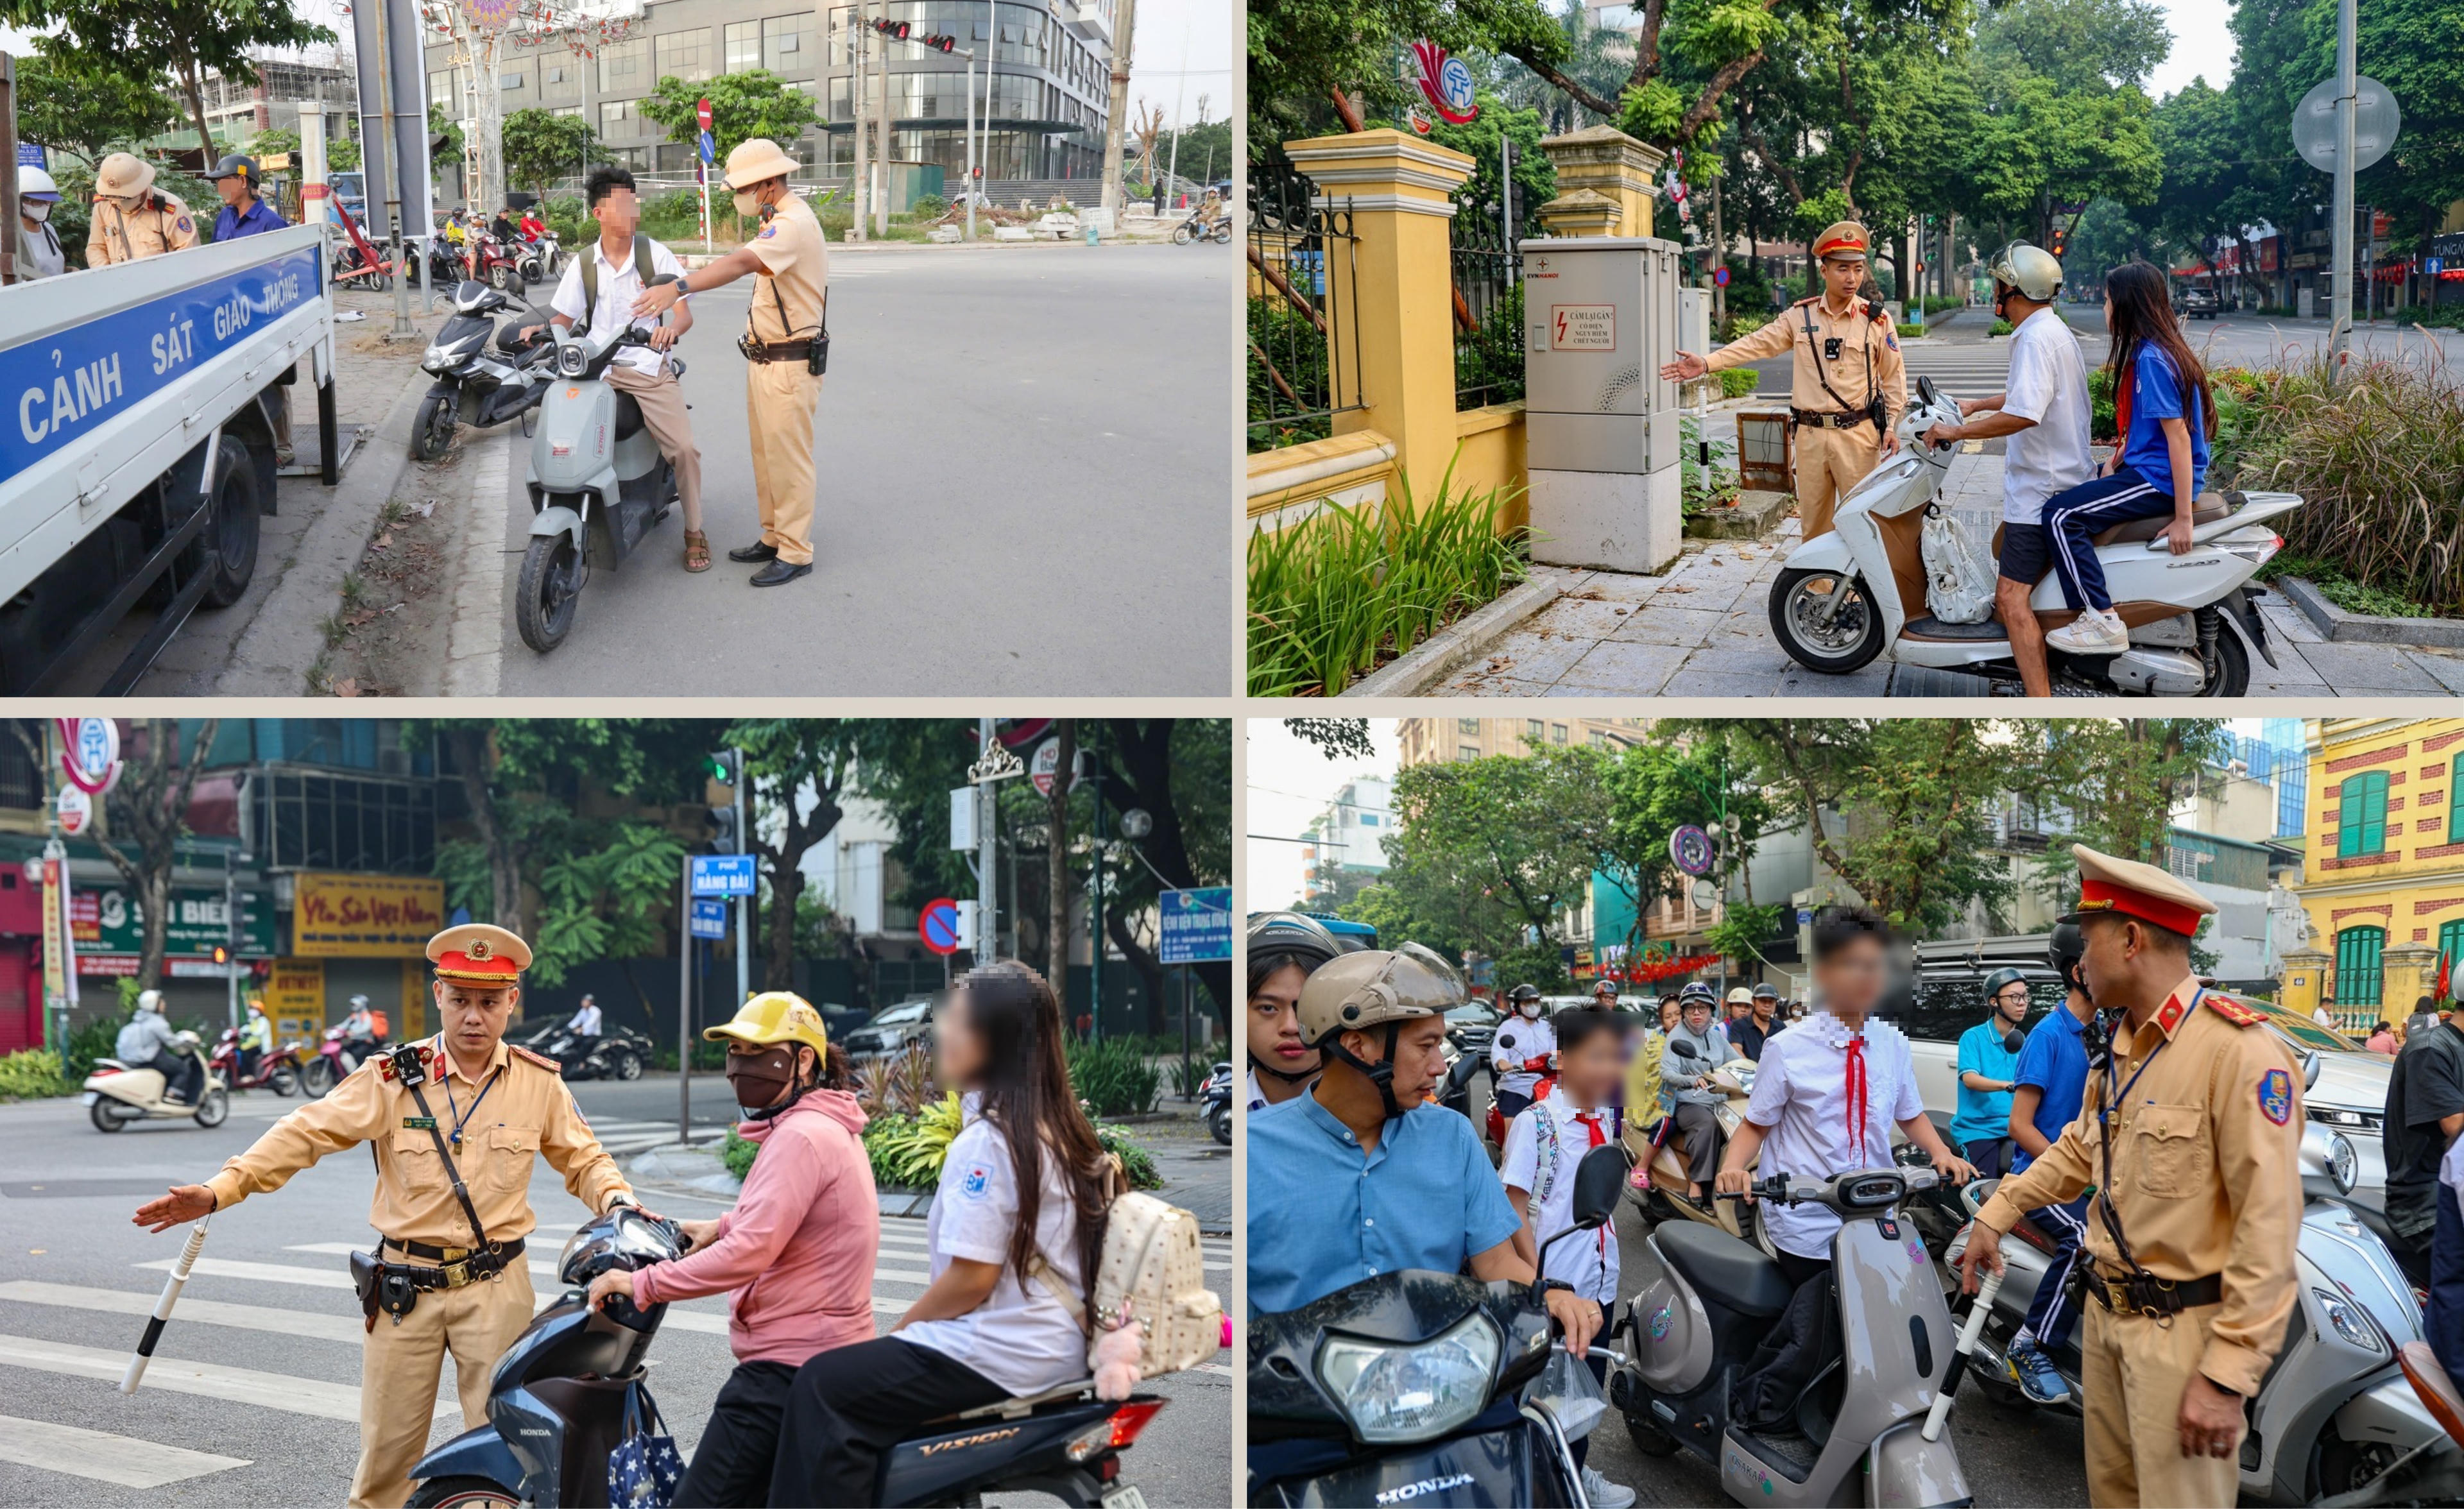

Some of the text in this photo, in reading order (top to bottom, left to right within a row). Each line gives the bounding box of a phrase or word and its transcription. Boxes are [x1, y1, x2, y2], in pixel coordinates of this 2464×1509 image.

[19, 271, 298, 444] CẢNH SÁT GIAO THÔNG
[520, 1428, 551, 1437] HONDA
[919, 1427, 1020, 1458] VISION
[1375, 1472, 1475, 1508] HONDA
